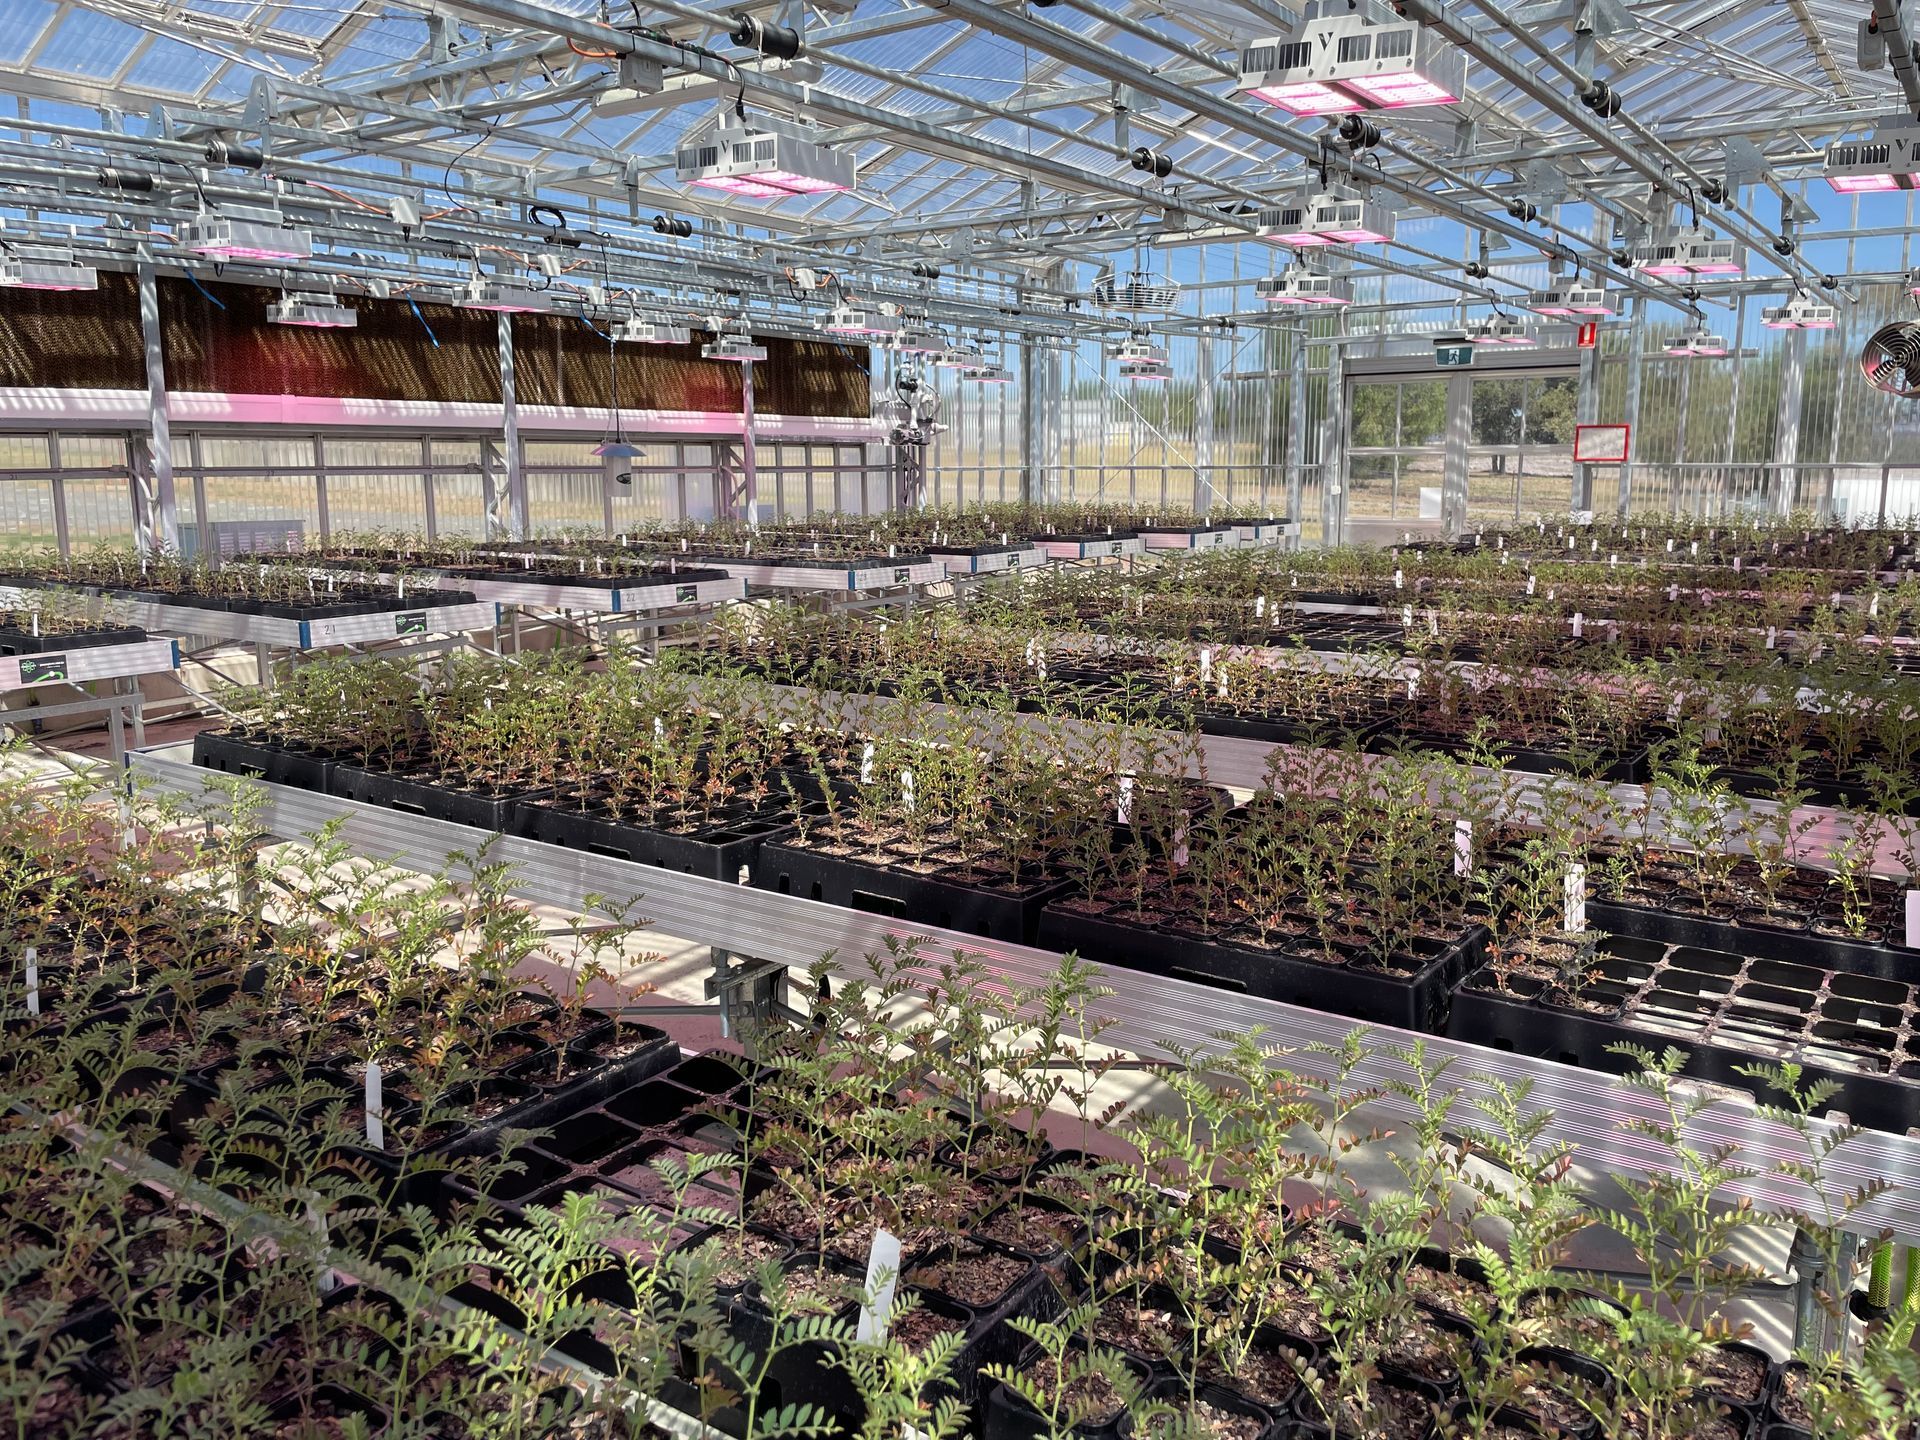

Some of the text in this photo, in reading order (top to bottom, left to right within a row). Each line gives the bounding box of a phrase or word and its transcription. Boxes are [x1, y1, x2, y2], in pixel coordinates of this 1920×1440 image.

[1318, 31, 1333, 51] V
[720, 139, 729, 153] V
[1895, 138, 1909, 152] V
[626, 593, 636, 602] 22
[324, 624, 336, 635] 21
